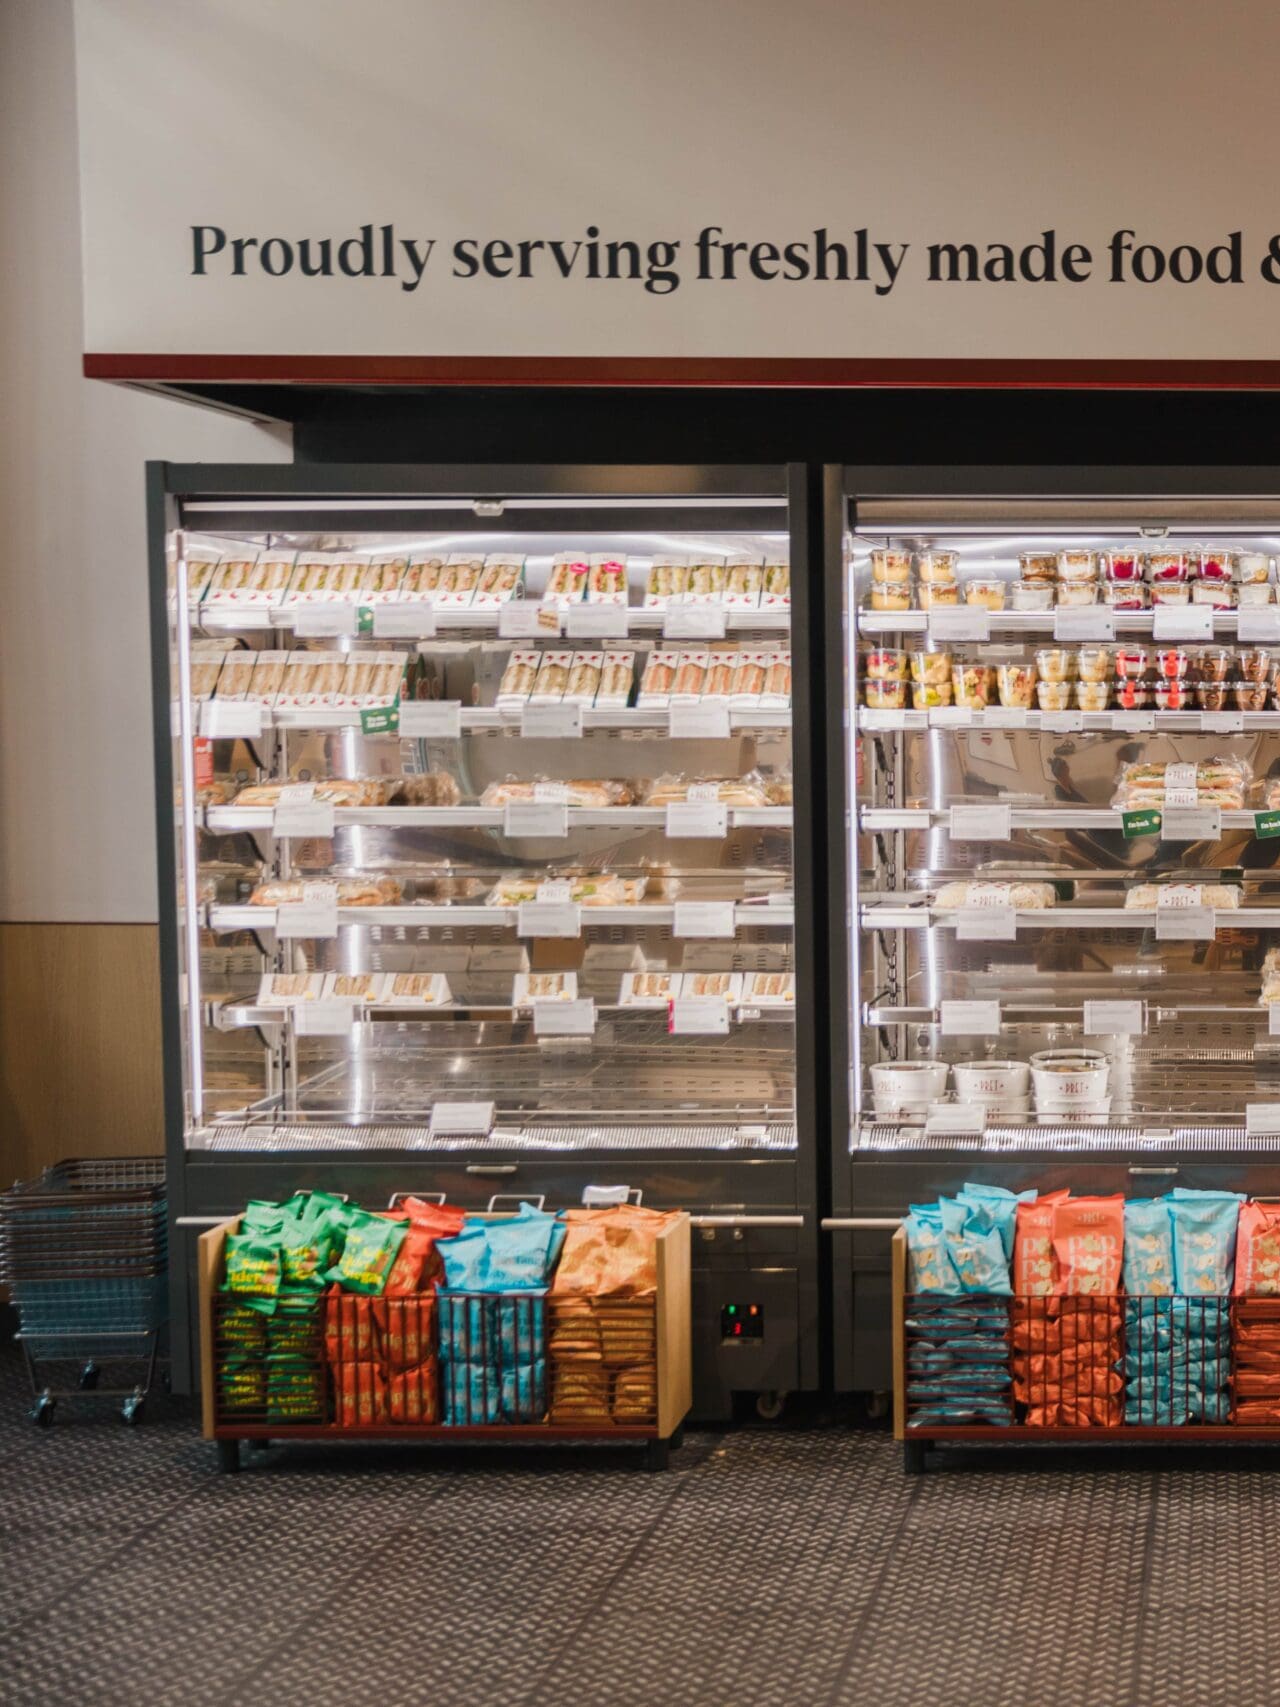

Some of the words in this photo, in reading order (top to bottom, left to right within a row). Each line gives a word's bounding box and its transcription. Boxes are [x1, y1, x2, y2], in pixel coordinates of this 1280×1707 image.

[191, 224, 436, 292] Proudly
[453, 226, 681, 295] serving
[694, 226, 910, 296] freshly
[927, 229, 1093, 283] made
[1107, 229, 1245, 284] food
[980, 1079, 998, 1092] PRET
[1065, 1082, 1084, 1093] PRET
